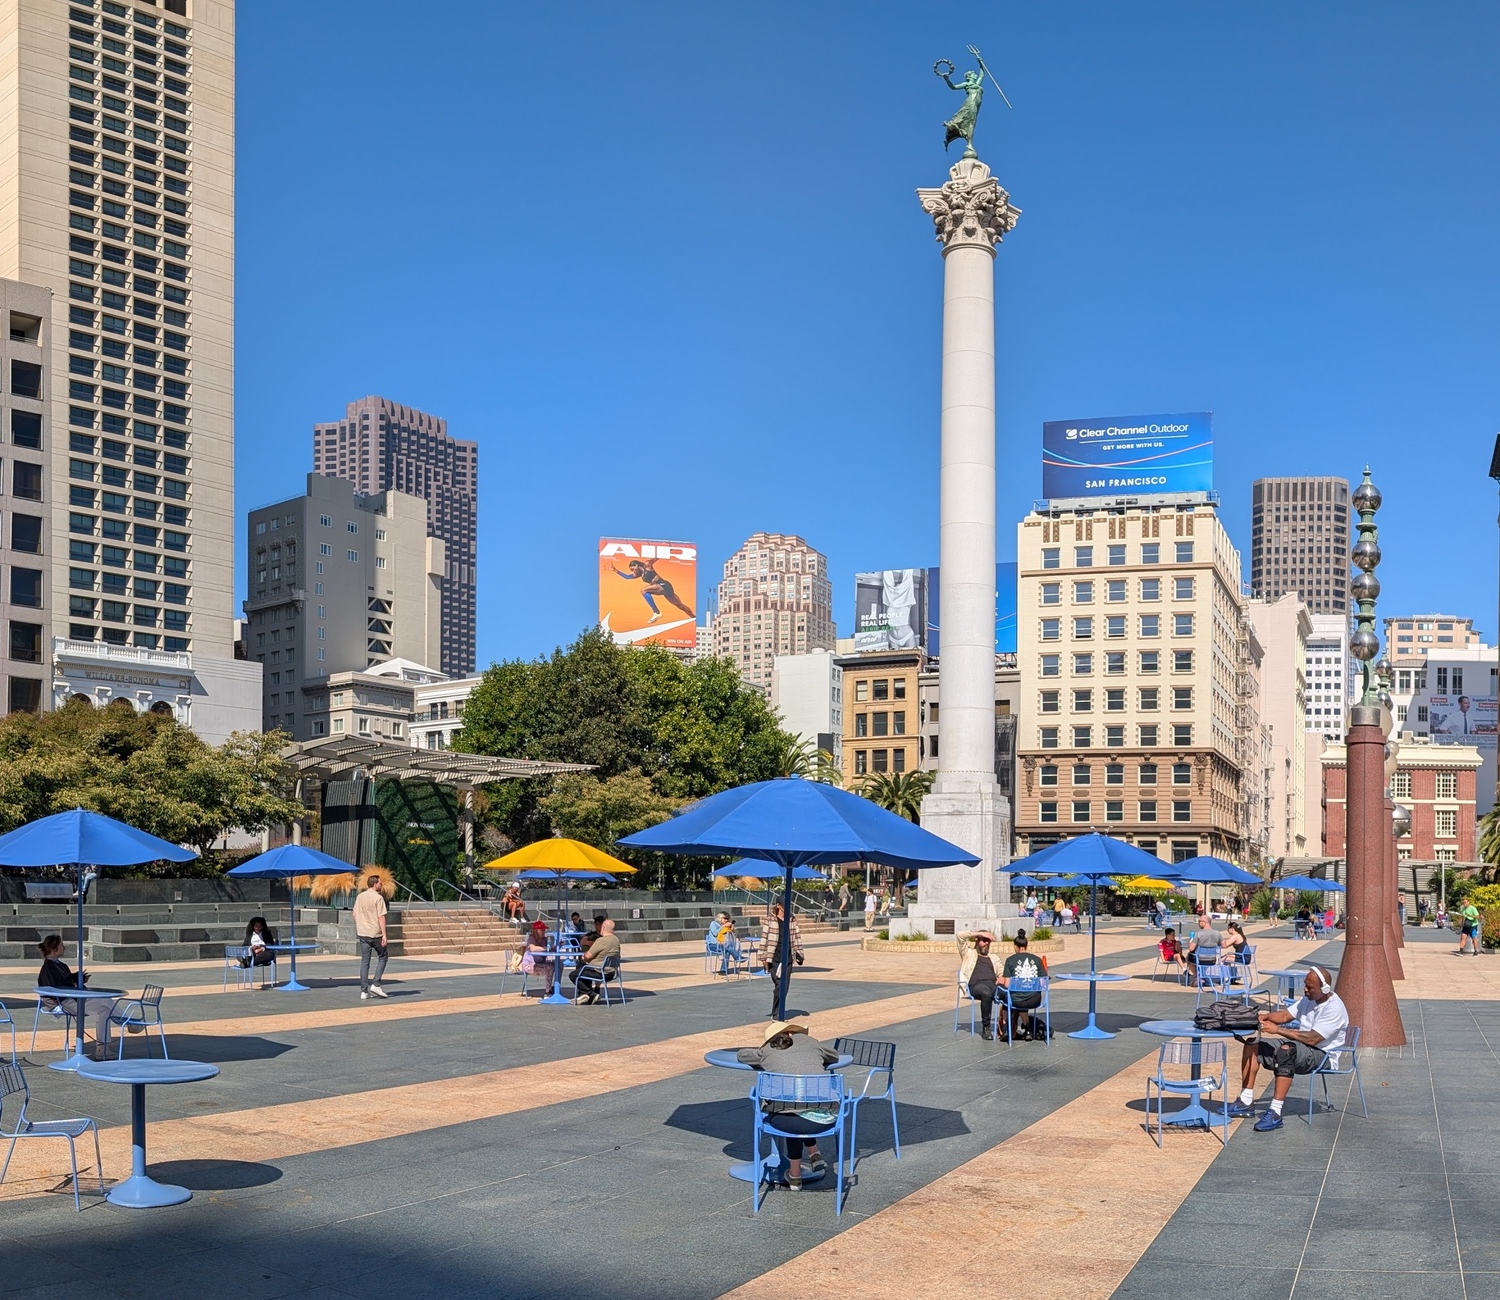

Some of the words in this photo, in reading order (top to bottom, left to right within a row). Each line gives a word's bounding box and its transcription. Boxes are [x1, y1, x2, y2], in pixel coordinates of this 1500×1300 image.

[1079, 428, 1105, 438] Clear
[1106, 425, 1148, 436] Channel
[1149, 423, 1189, 433] Outdoor
[1085, 480, 1105, 488] SAN
[1109, 476, 1167, 487] FRANCISCO
[600, 543, 697, 561] AIR
[85, 671, 160, 686] WILLIAMS-SONOMA
